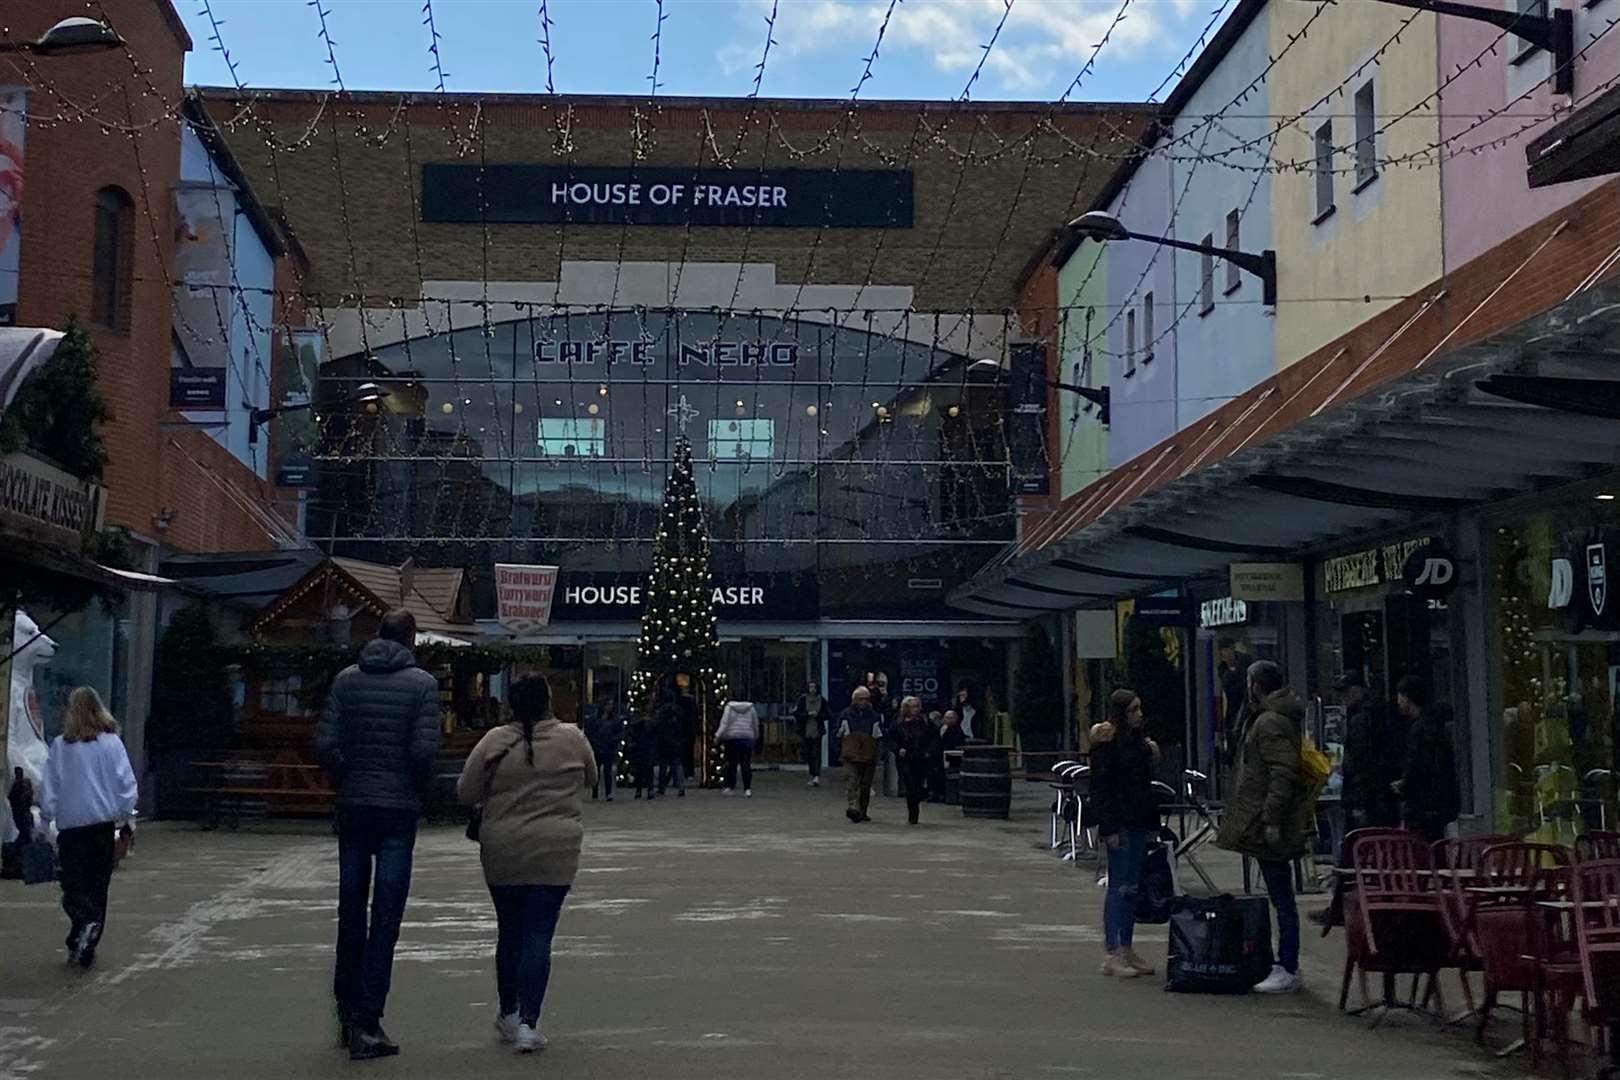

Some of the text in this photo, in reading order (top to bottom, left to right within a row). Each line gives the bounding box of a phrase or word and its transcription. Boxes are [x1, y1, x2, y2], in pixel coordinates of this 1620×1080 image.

[551, 182, 788, 208] HOUSE OF FRASER
[679, 342, 801, 367] NERO
[0, 463, 51, 519] HOCOLATE
[1383, 535, 1432, 580] VALE
[1414, 557, 1454, 585] JD
[565, 586, 765, 605] HOUSE ASER
[902, 678, 938, 693] £50
